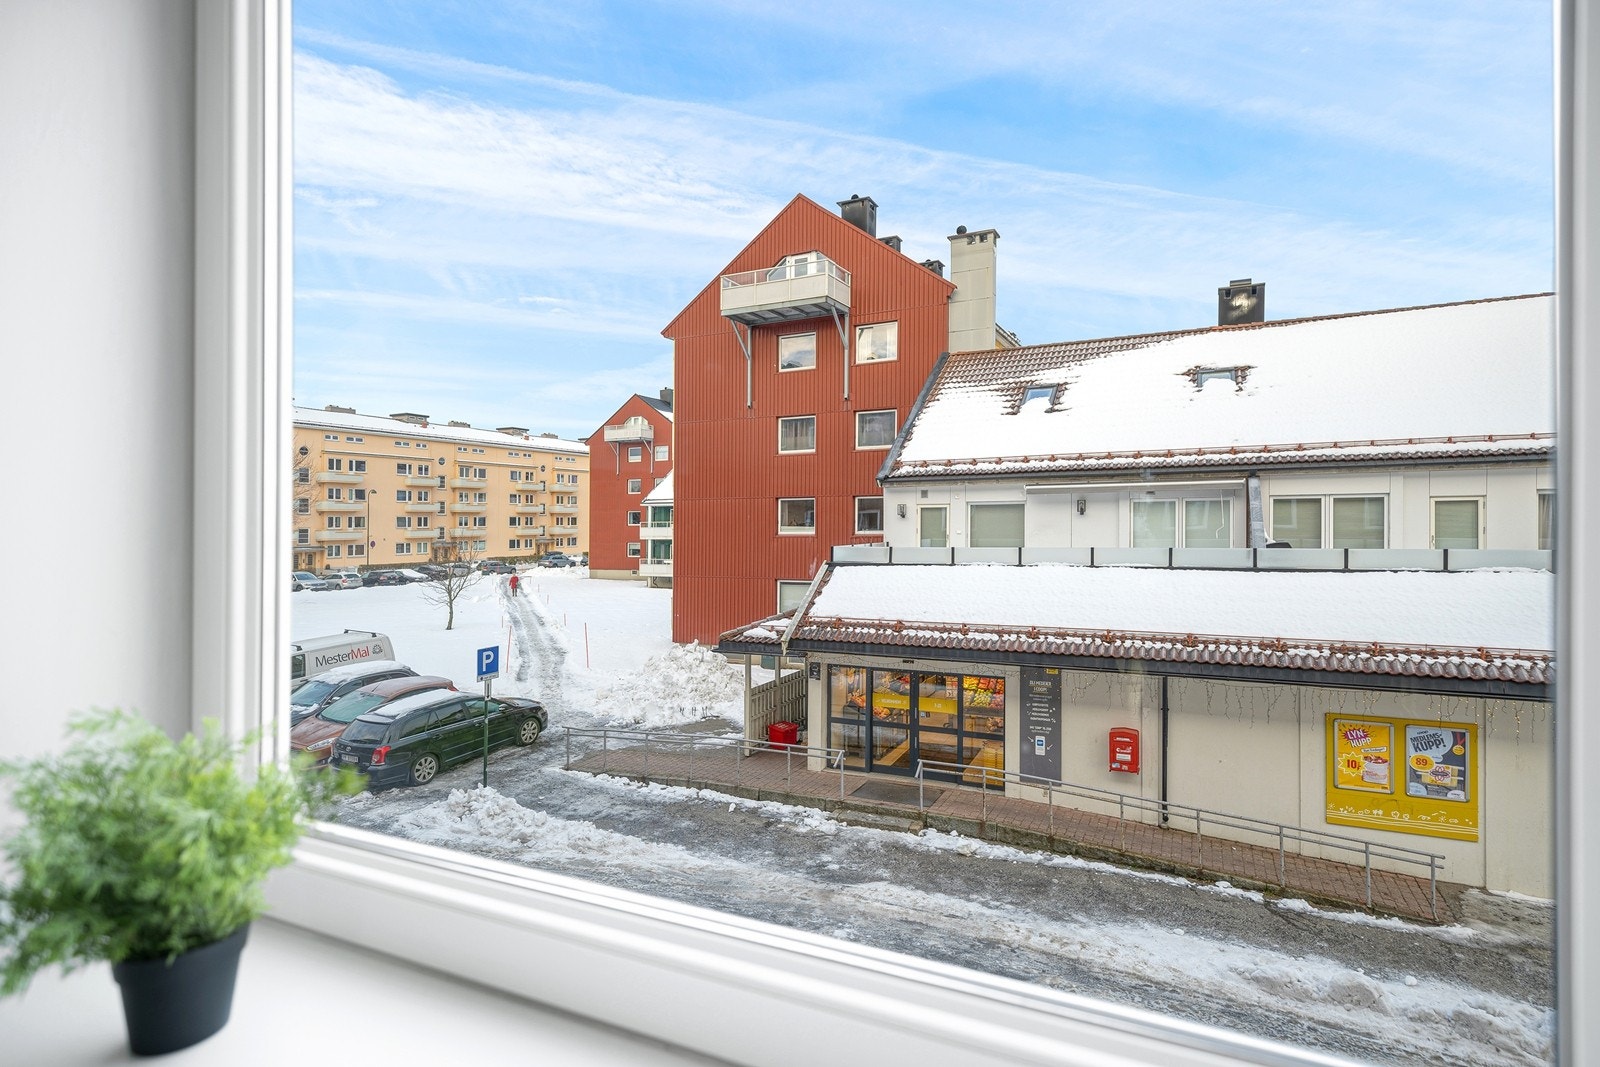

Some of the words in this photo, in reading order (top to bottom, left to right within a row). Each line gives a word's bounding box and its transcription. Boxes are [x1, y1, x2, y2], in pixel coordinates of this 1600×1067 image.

[315, 646, 370, 667] MesterMal
[482, 650, 494, 672] P
[1412, 738, 1447, 753] KUPP!
[1415, 757, 1428, 766] 89
